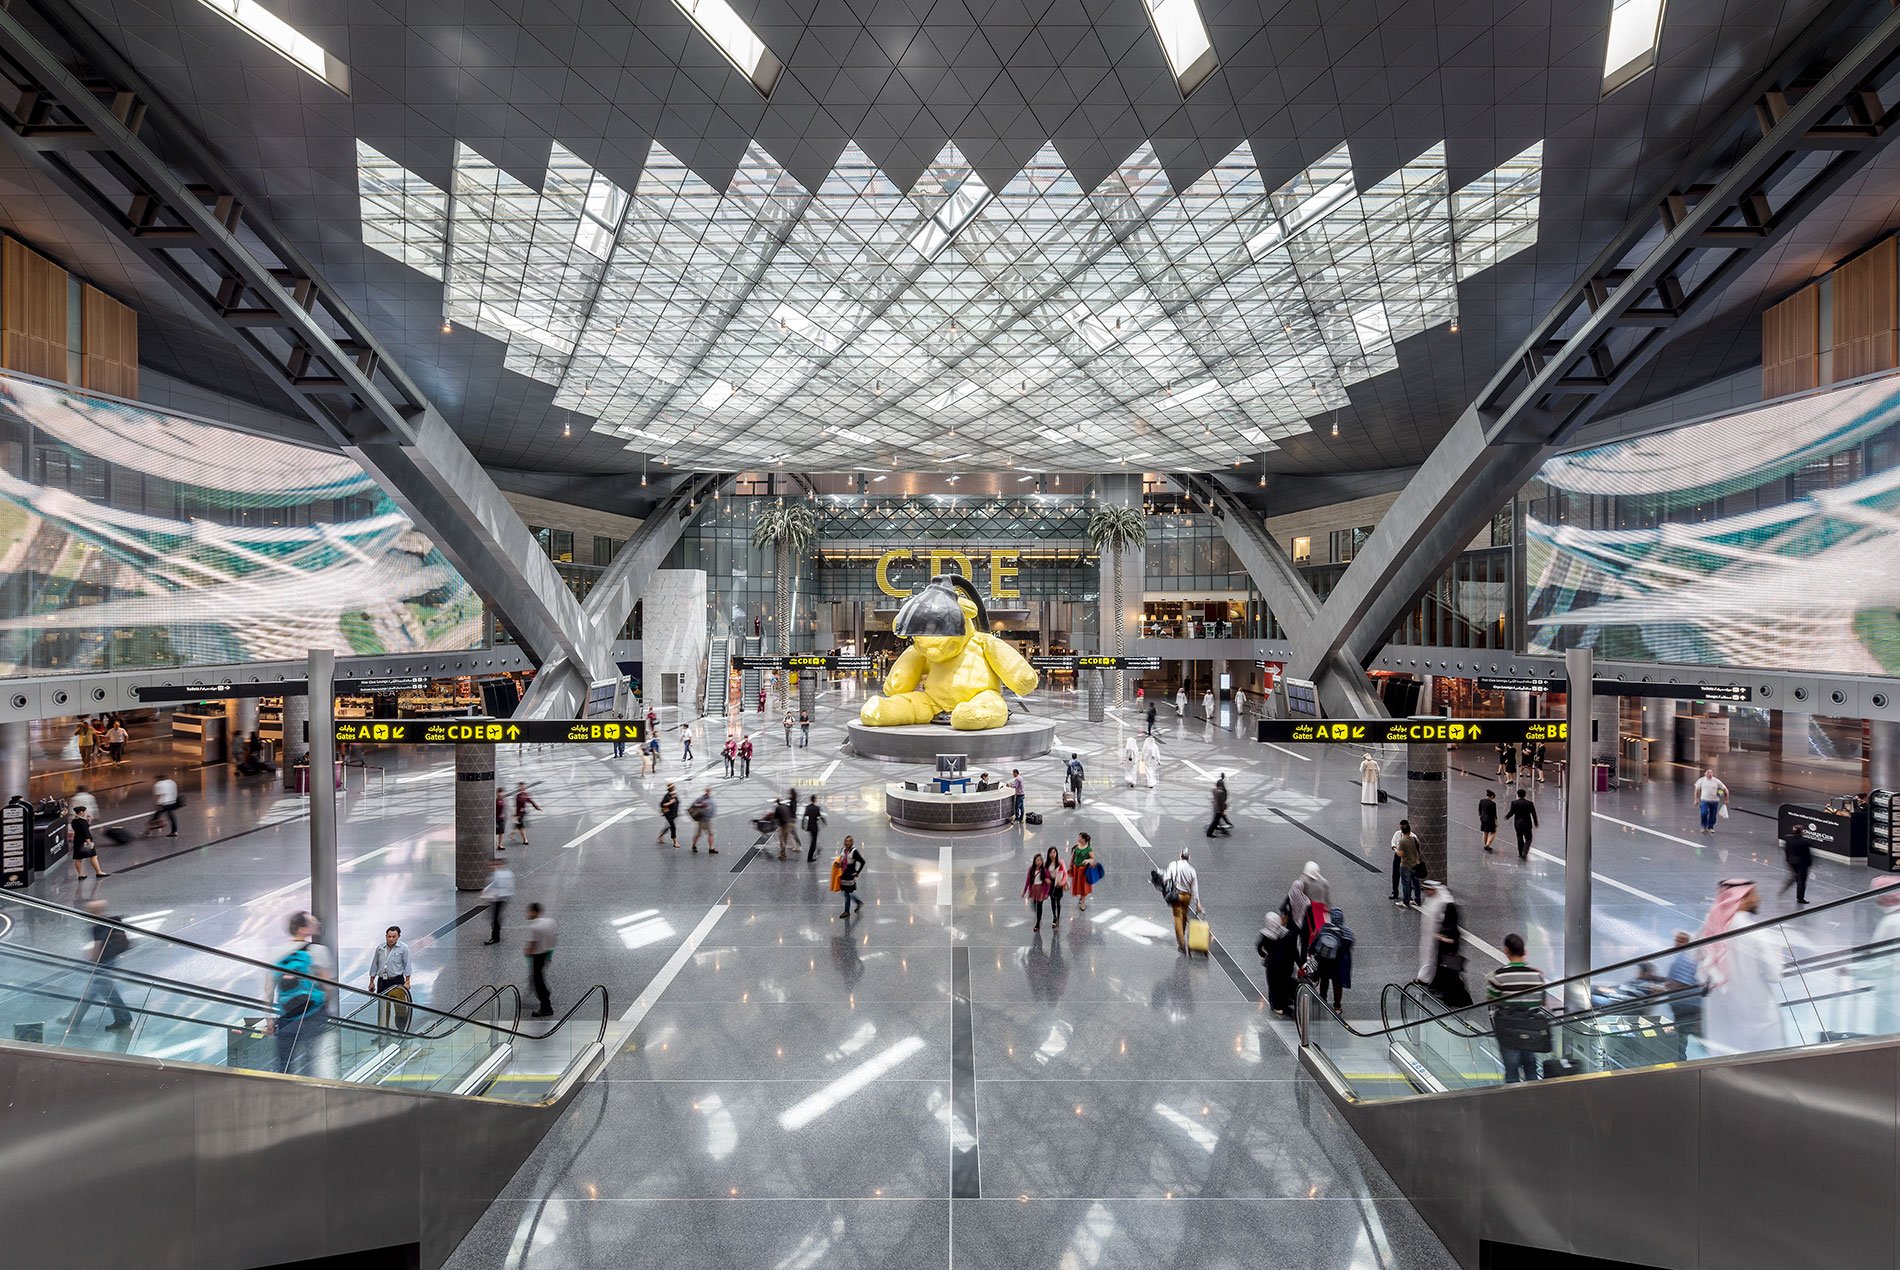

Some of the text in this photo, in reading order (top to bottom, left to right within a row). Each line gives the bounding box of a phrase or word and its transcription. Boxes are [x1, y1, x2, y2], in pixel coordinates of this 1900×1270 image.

[358, 725, 371, 738] A
[448, 726, 484, 739] CDE
[591, 725, 601, 738] B
[1316, 725, 1329, 738] A
[1410, 726, 1446, 738] CDE
[1547, 724, 1557, 738] B
